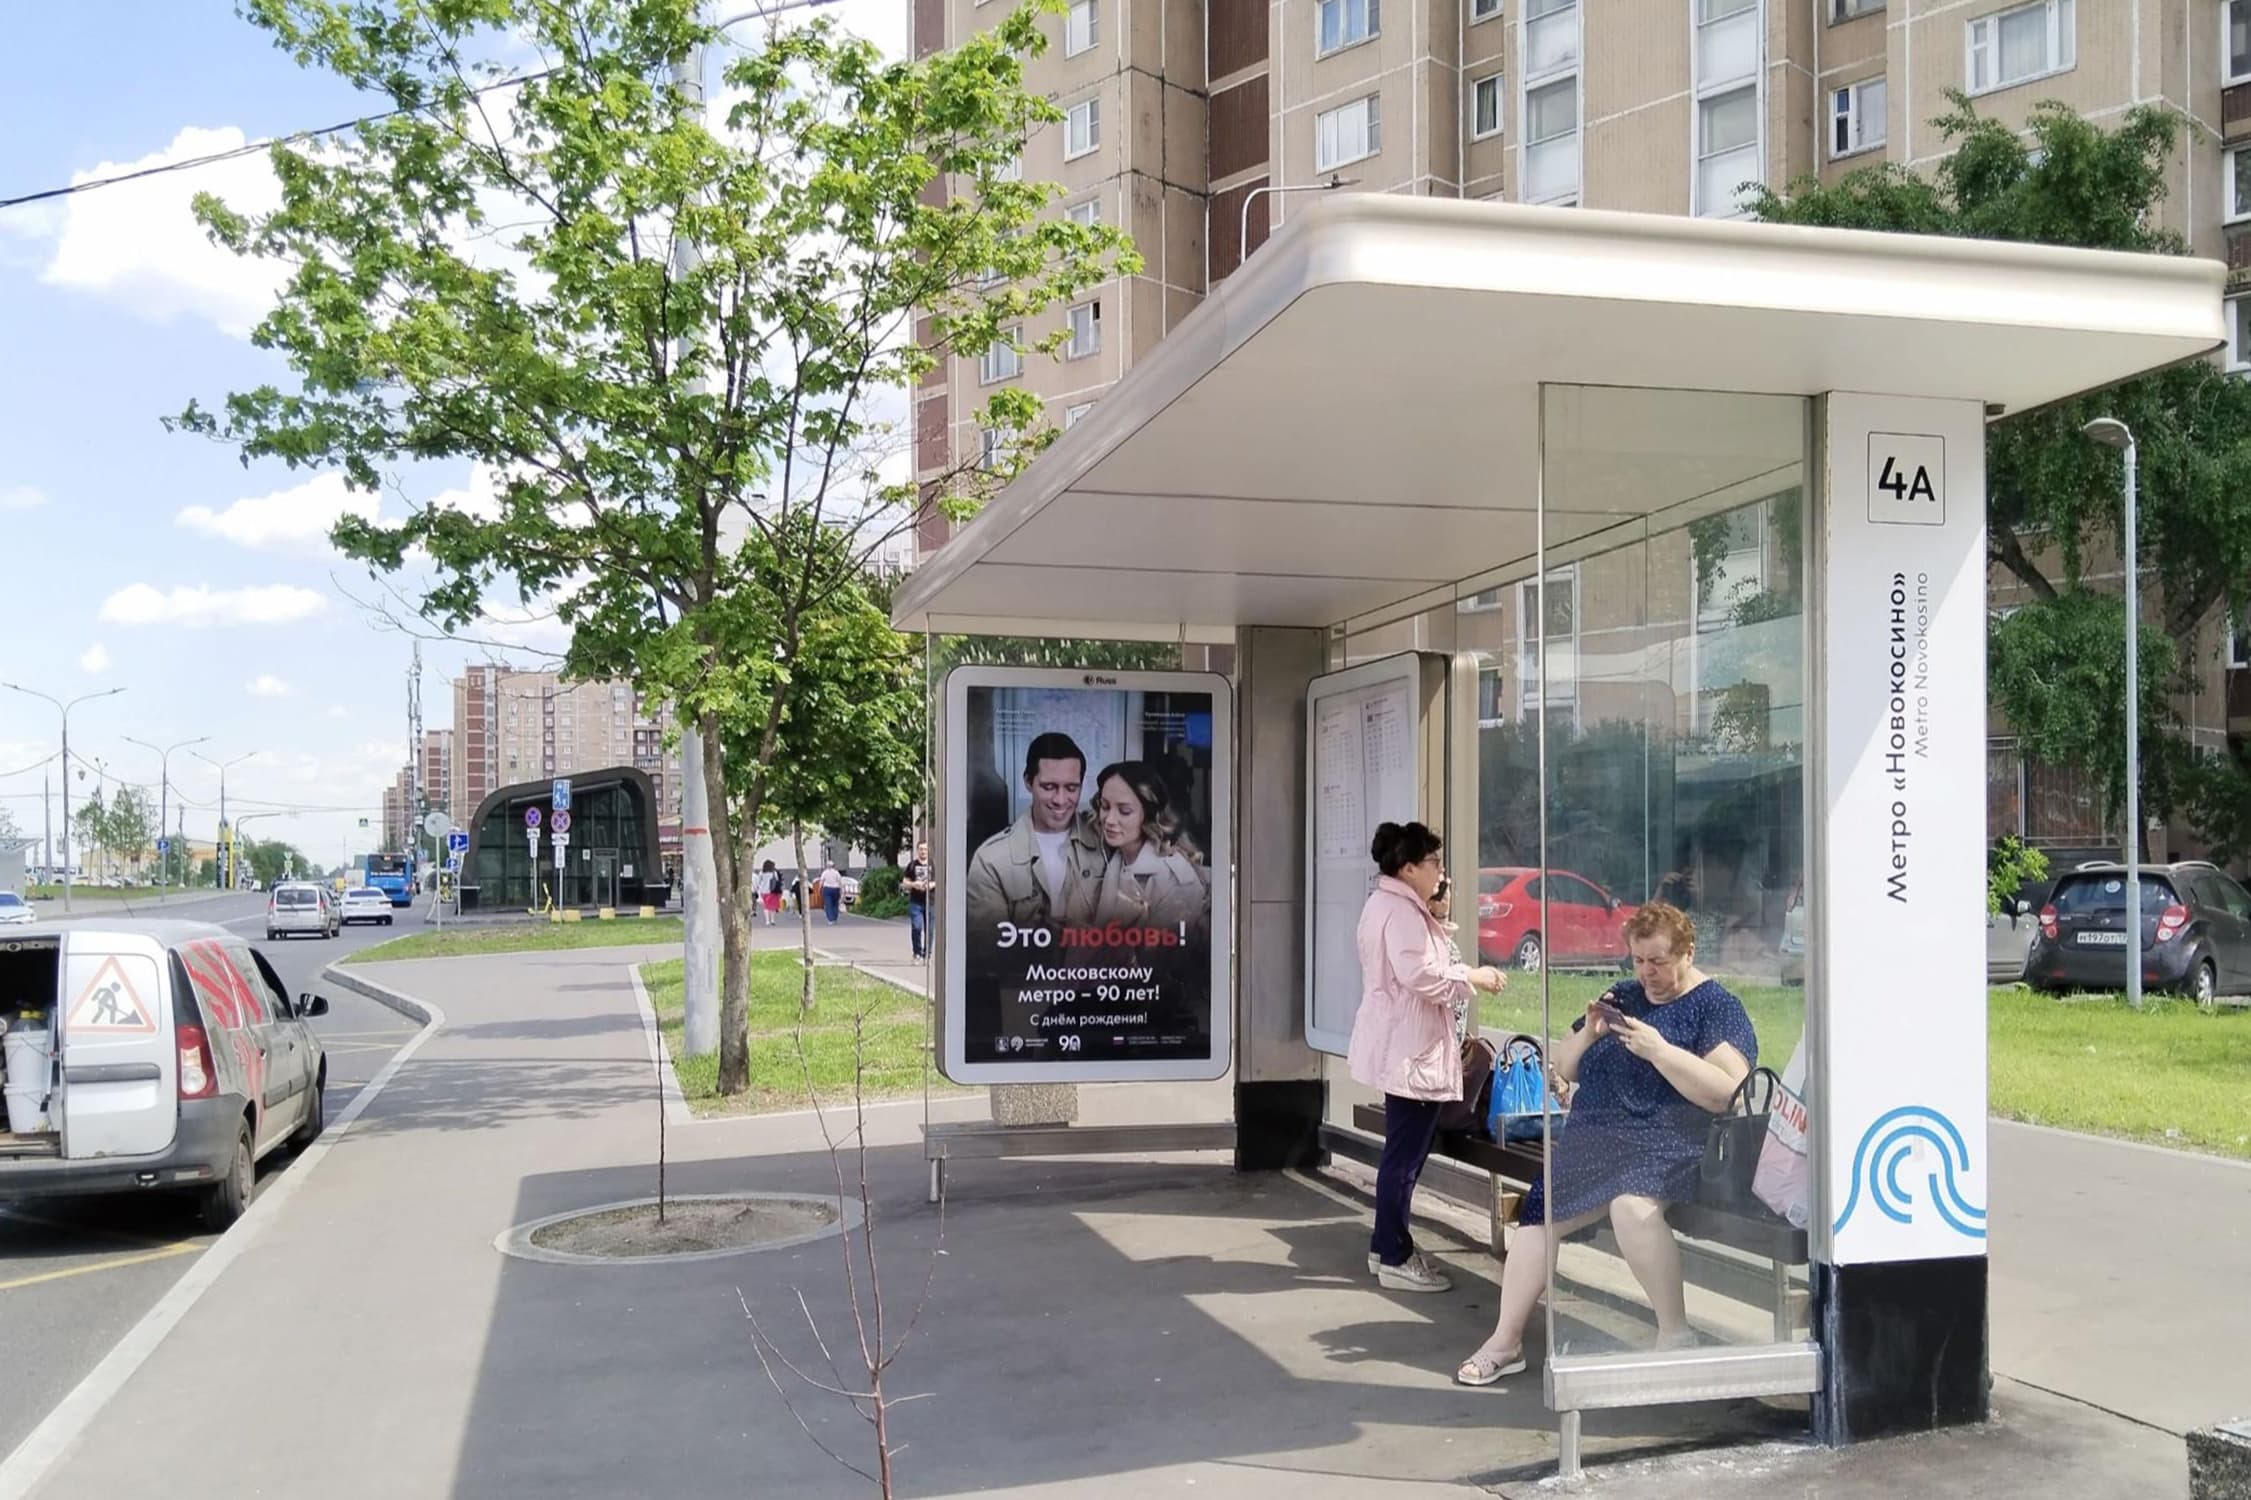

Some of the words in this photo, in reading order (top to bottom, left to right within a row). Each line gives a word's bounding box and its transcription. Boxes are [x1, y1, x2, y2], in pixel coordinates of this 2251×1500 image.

[1914, 572, 1928, 689] Novokosino
[1885, 572, 1906, 791] «Новокосино»
[1914, 696, 1928, 758] Metro
[1887, 801, 1911, 903] Метро
[996, 921, 1052, 948] Это
[1060, 919, 1187, 948] любовь!
[1018, 988, 1076, 1005] метро
[1096, 985, 1120, 1001] 90
[1124, 984, 1160, 1001] лет!
[1025, 964, 1153, 983] Московскому
[1030, 1014, 1039, 1026] С
[1041, 1014, 1076, 1027] днём
[1079, 1012, 1148, 1027] рождения!
